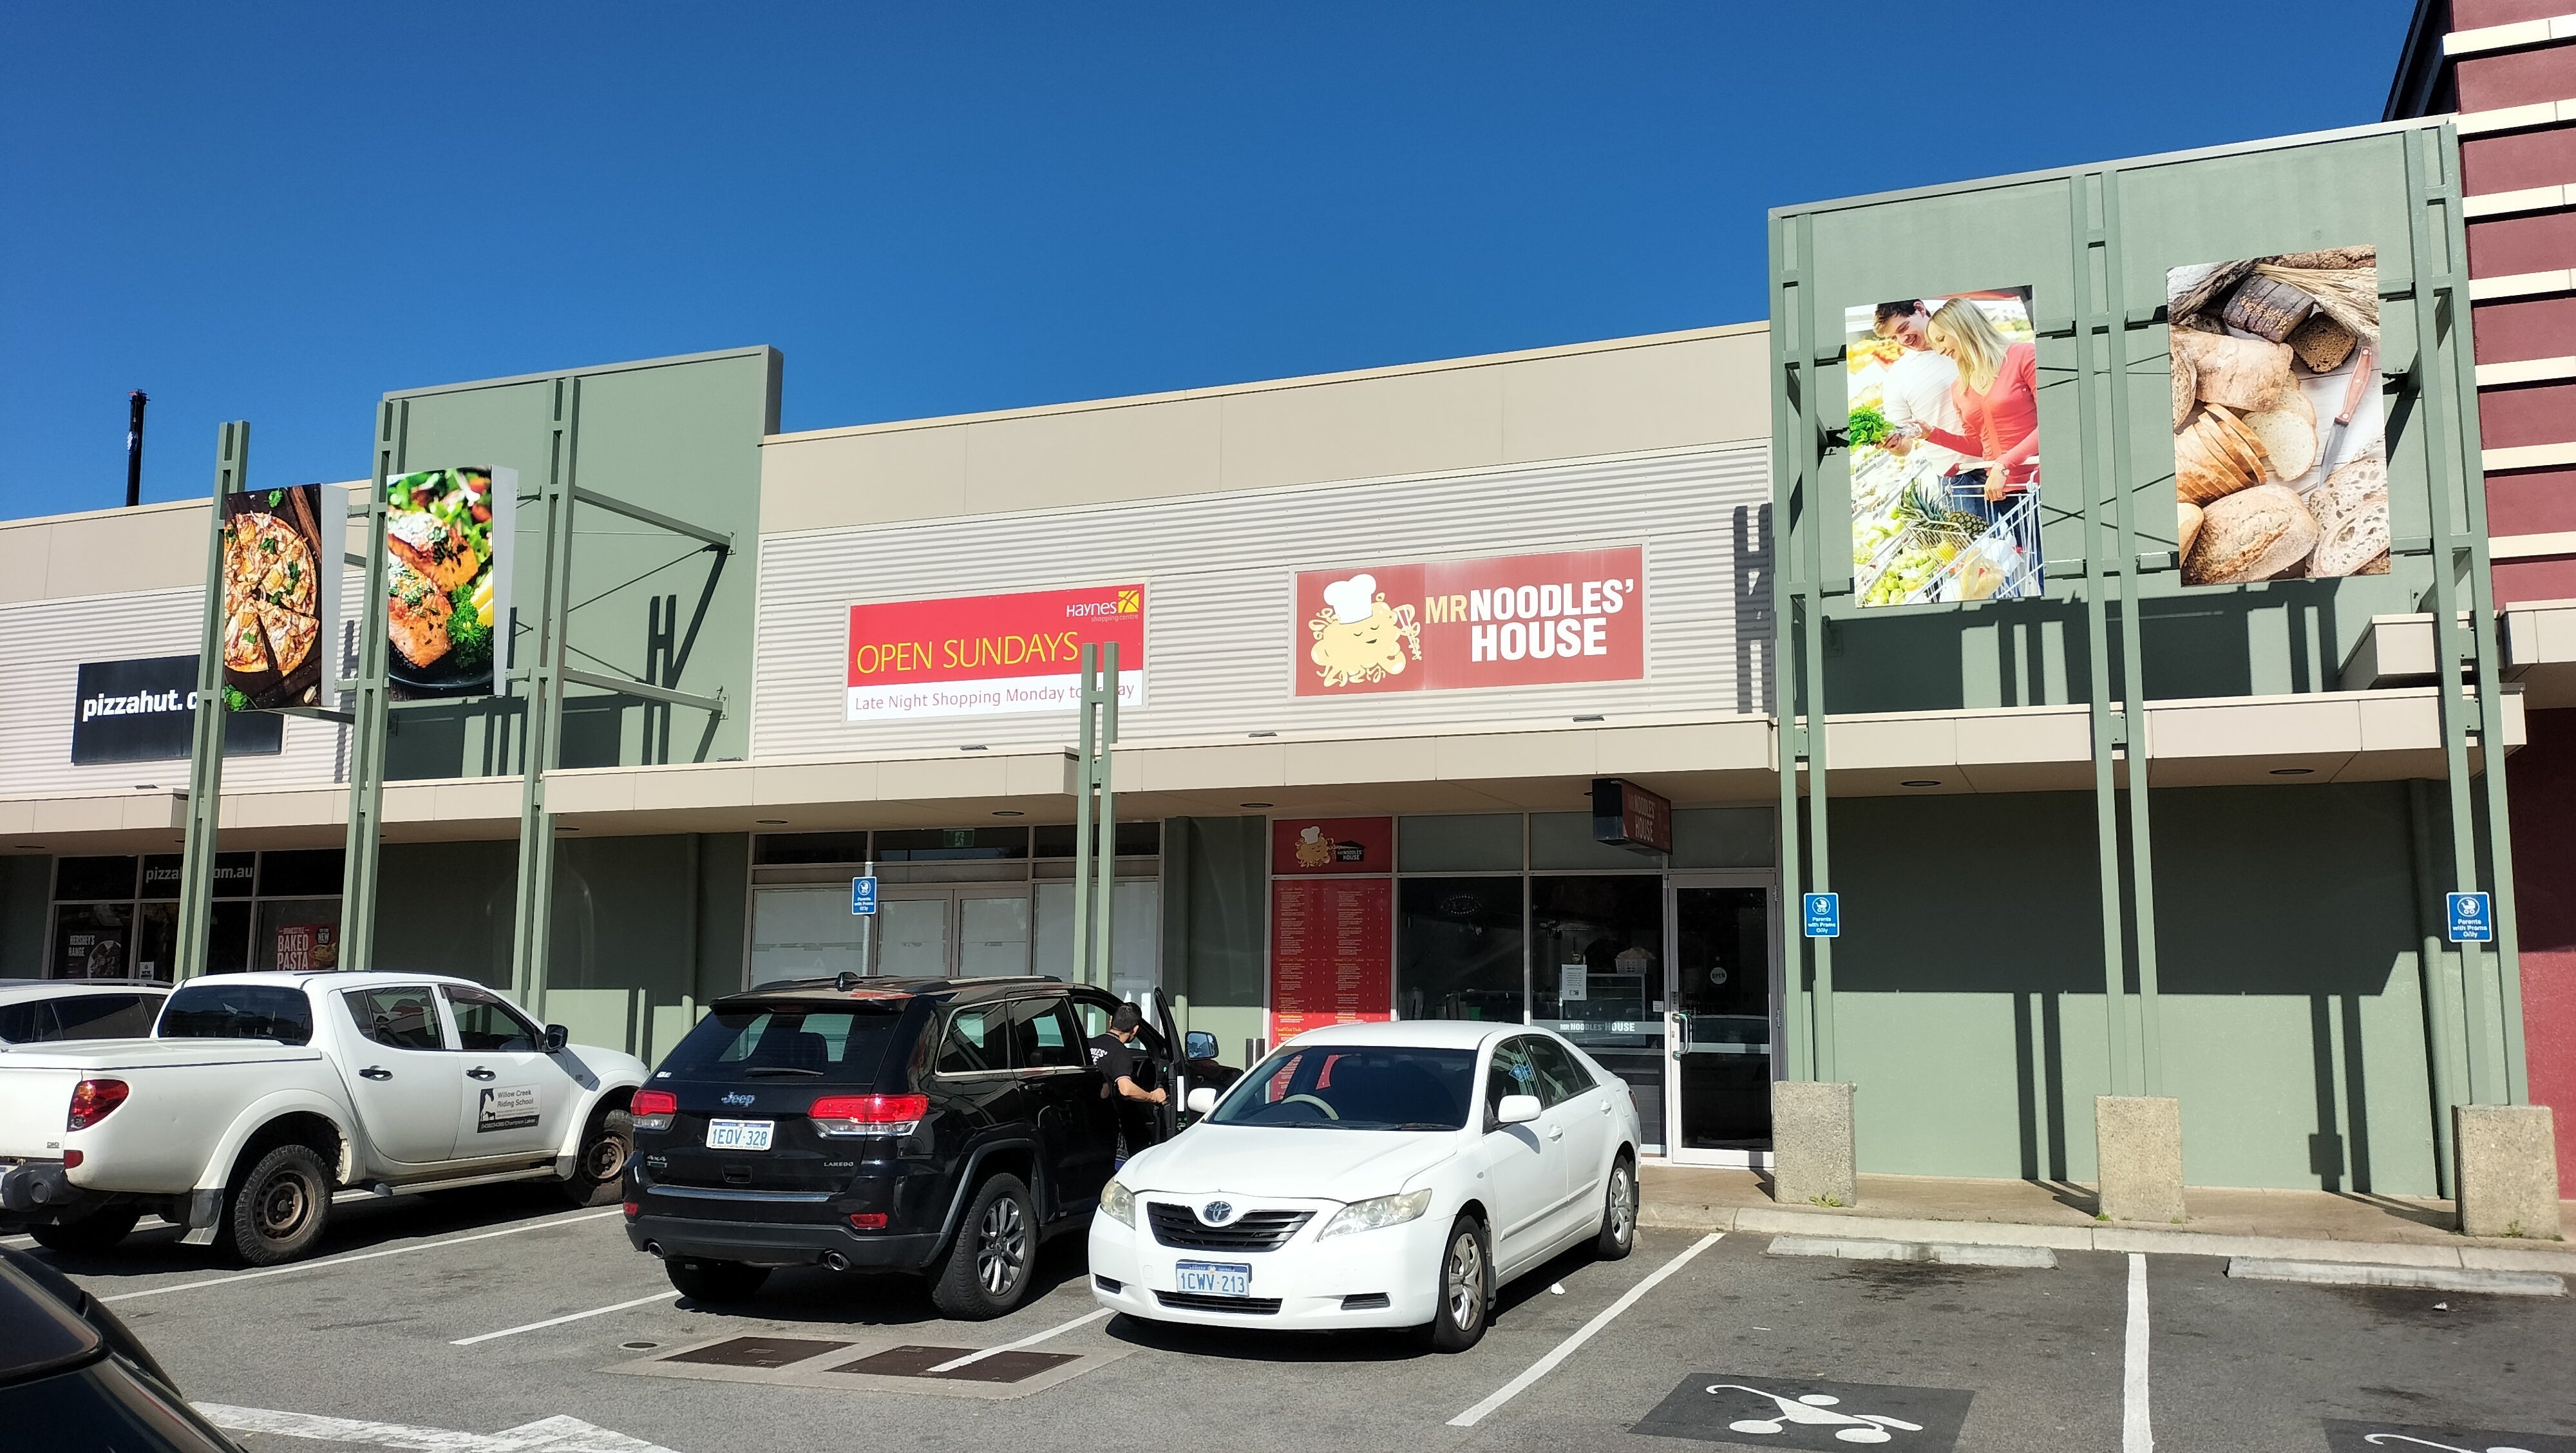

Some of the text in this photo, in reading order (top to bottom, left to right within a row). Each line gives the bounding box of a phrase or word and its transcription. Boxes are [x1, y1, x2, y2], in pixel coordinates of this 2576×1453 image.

[1066, 602, 1117, 617] Haynes
[1425, 578, 1634, 625] MR NOODLES'
[1471, 617, 1607, 663] HOUSE
[857, 631, 1079, 674] OPEN SUNDAYS
[82, 689, 198, 722] pizzahut.c
[855, 698, 884, 710] Late
[889, 694, 927, 711] Night
[932, 690, 1001, 708] Shopping
[1006, 687, 1065, 703] Monday
[1635, 815, 1654, 842] HOUSE
[277, 934, 309, 952] BAKED
[276, 951, 308, 971] PASTA
[1605, 1021, 1635, 1032] HOUSE
[515, 1097, 534, 1106] School
[721, 1090, 755, 1108] Jeep
